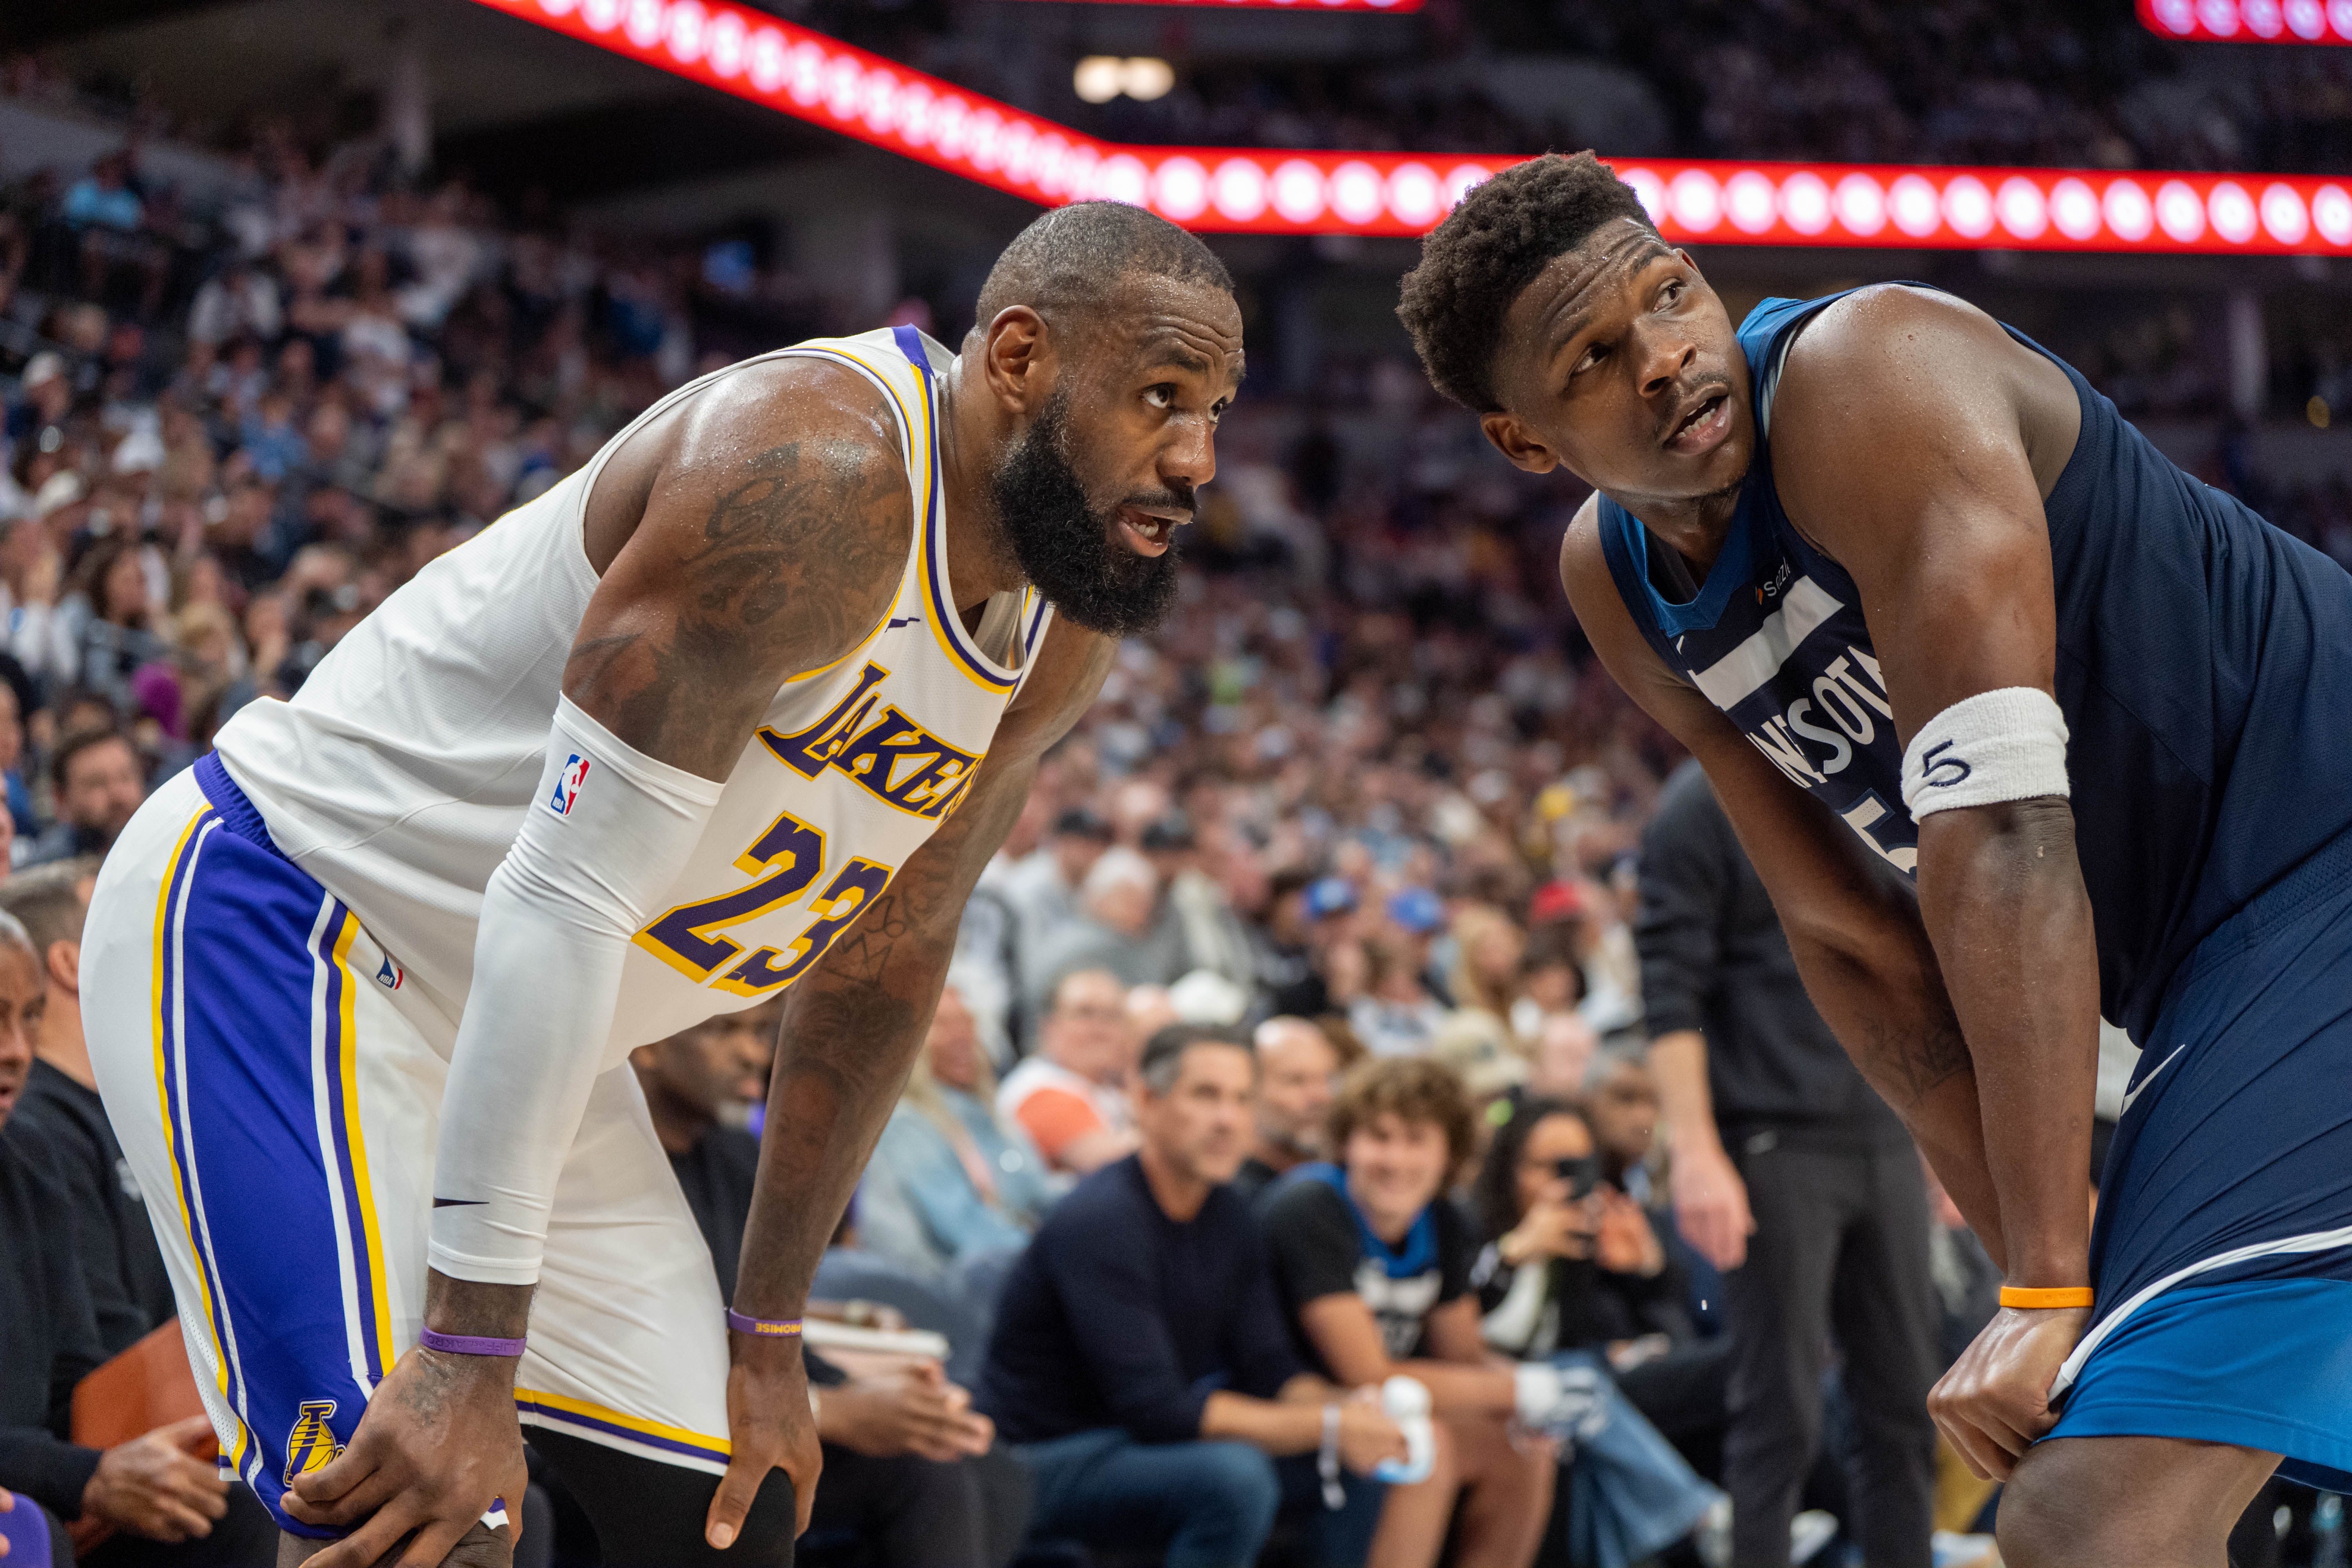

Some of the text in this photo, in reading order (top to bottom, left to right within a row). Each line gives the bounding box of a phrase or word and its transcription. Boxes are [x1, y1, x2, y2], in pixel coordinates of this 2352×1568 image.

[1922, 739, 1971, 788] 5
[552, 796, 564, 811] NBA
[630, 810, 894, 998] 23
[378, 974, 393, 985] NBA
[755, 1322, 802, 1334] PROMISE
